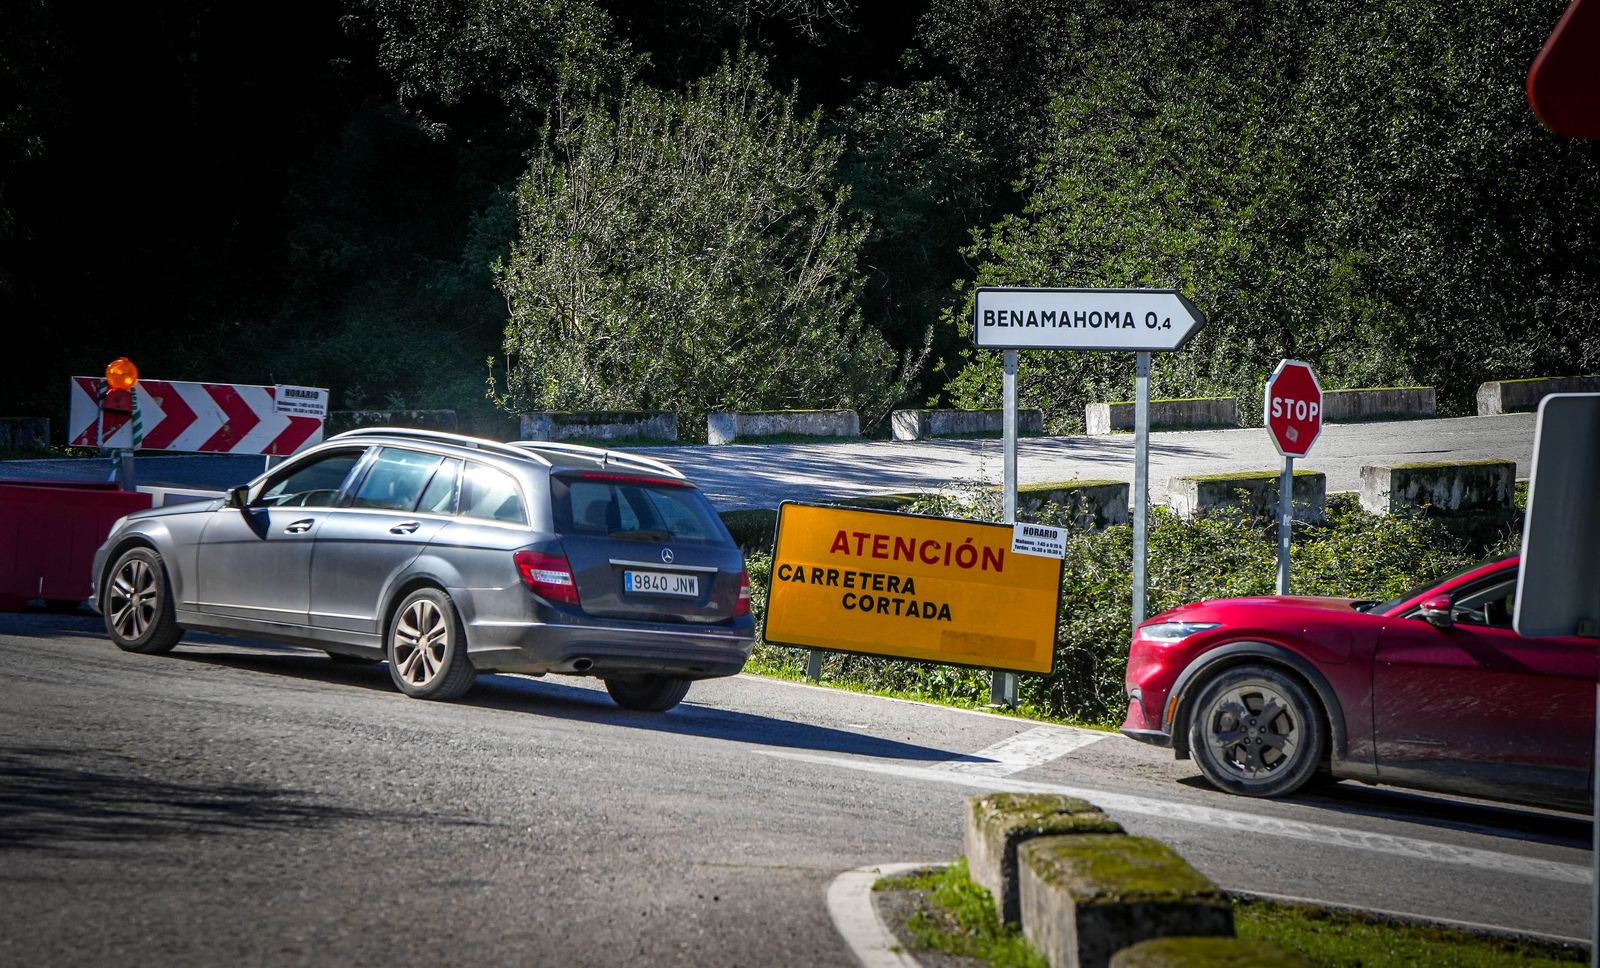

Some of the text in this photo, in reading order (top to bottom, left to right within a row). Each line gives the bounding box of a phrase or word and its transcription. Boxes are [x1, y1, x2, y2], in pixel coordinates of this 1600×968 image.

[983, 310, 1172, 330] BENAMAHOMA 0,4
[1272, 396, 1319, 422] STOP
[1023, 526, 1058, 539] HORARIO
[829, 530, 1005, 573] ATENCIÓN
[634, 574, 695, 594] 9840 JNW
[777, 564, 916, 596] CARRETERA
[842, 593, 952, 622] CORTADA
